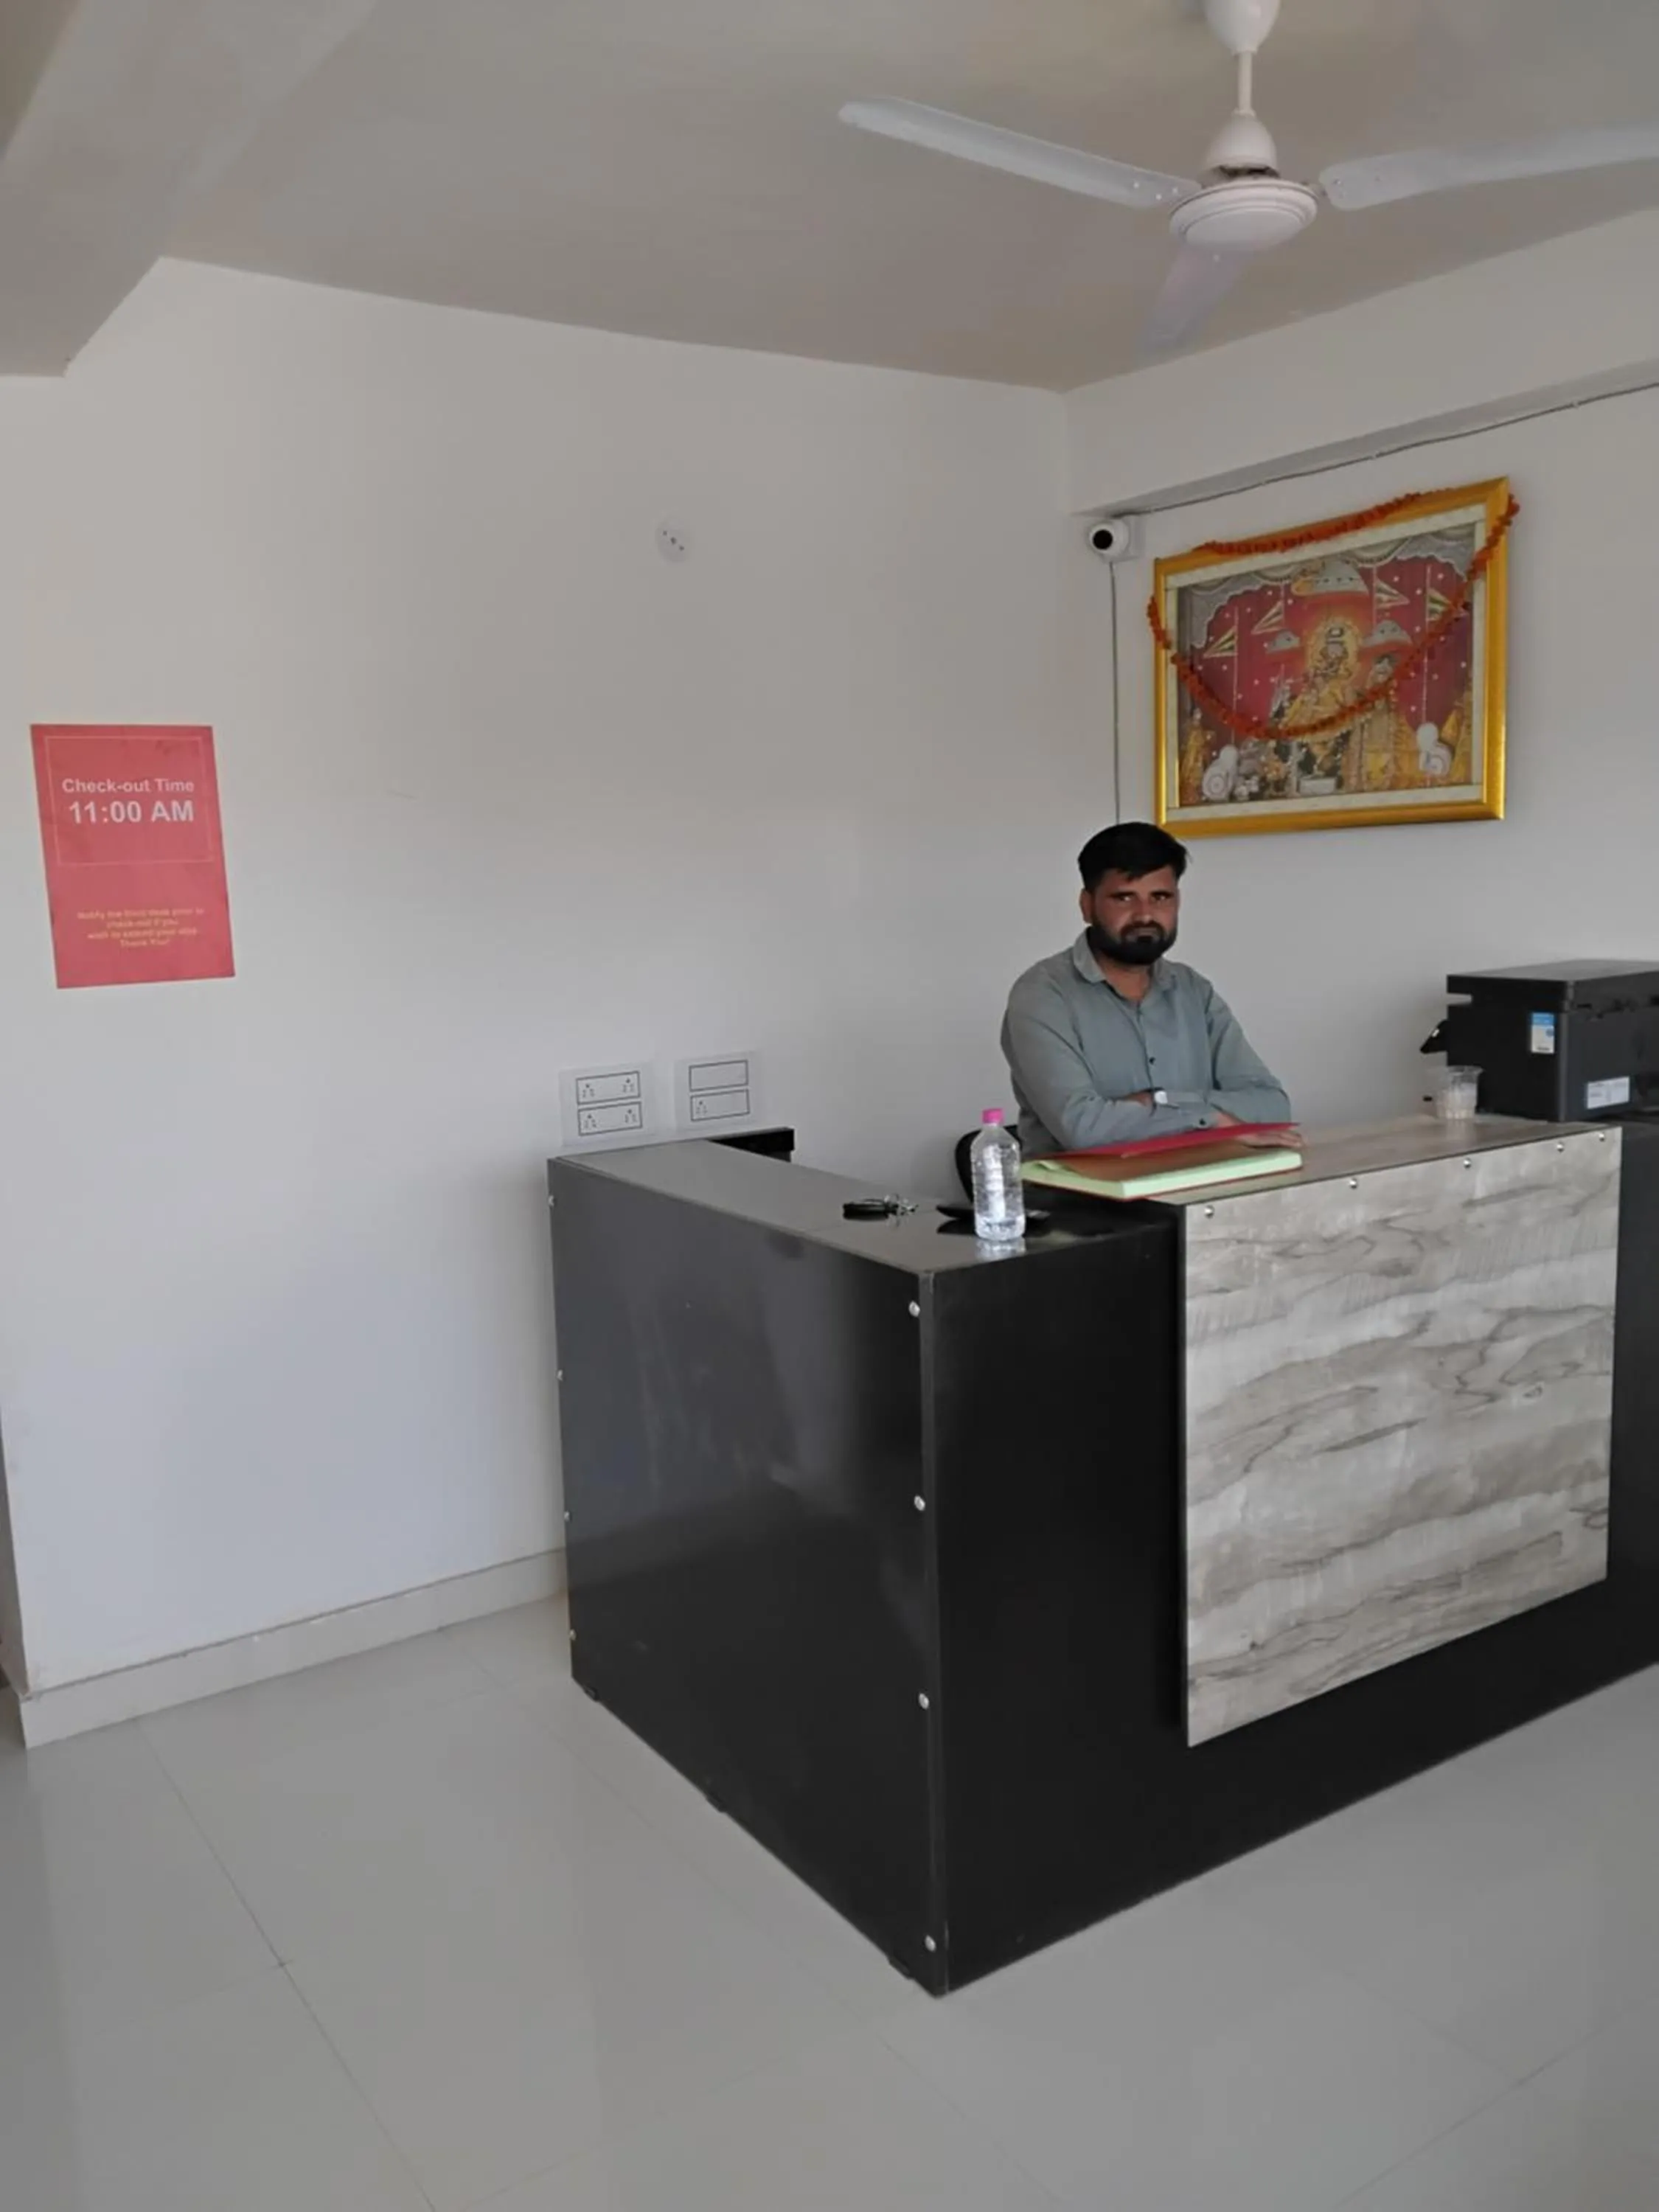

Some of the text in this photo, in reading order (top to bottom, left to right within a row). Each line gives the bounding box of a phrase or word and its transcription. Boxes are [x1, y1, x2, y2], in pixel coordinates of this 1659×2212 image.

[62, 778, 195, 793] Check-out Time
[69, 800, 194, 824] 11:00 AM
